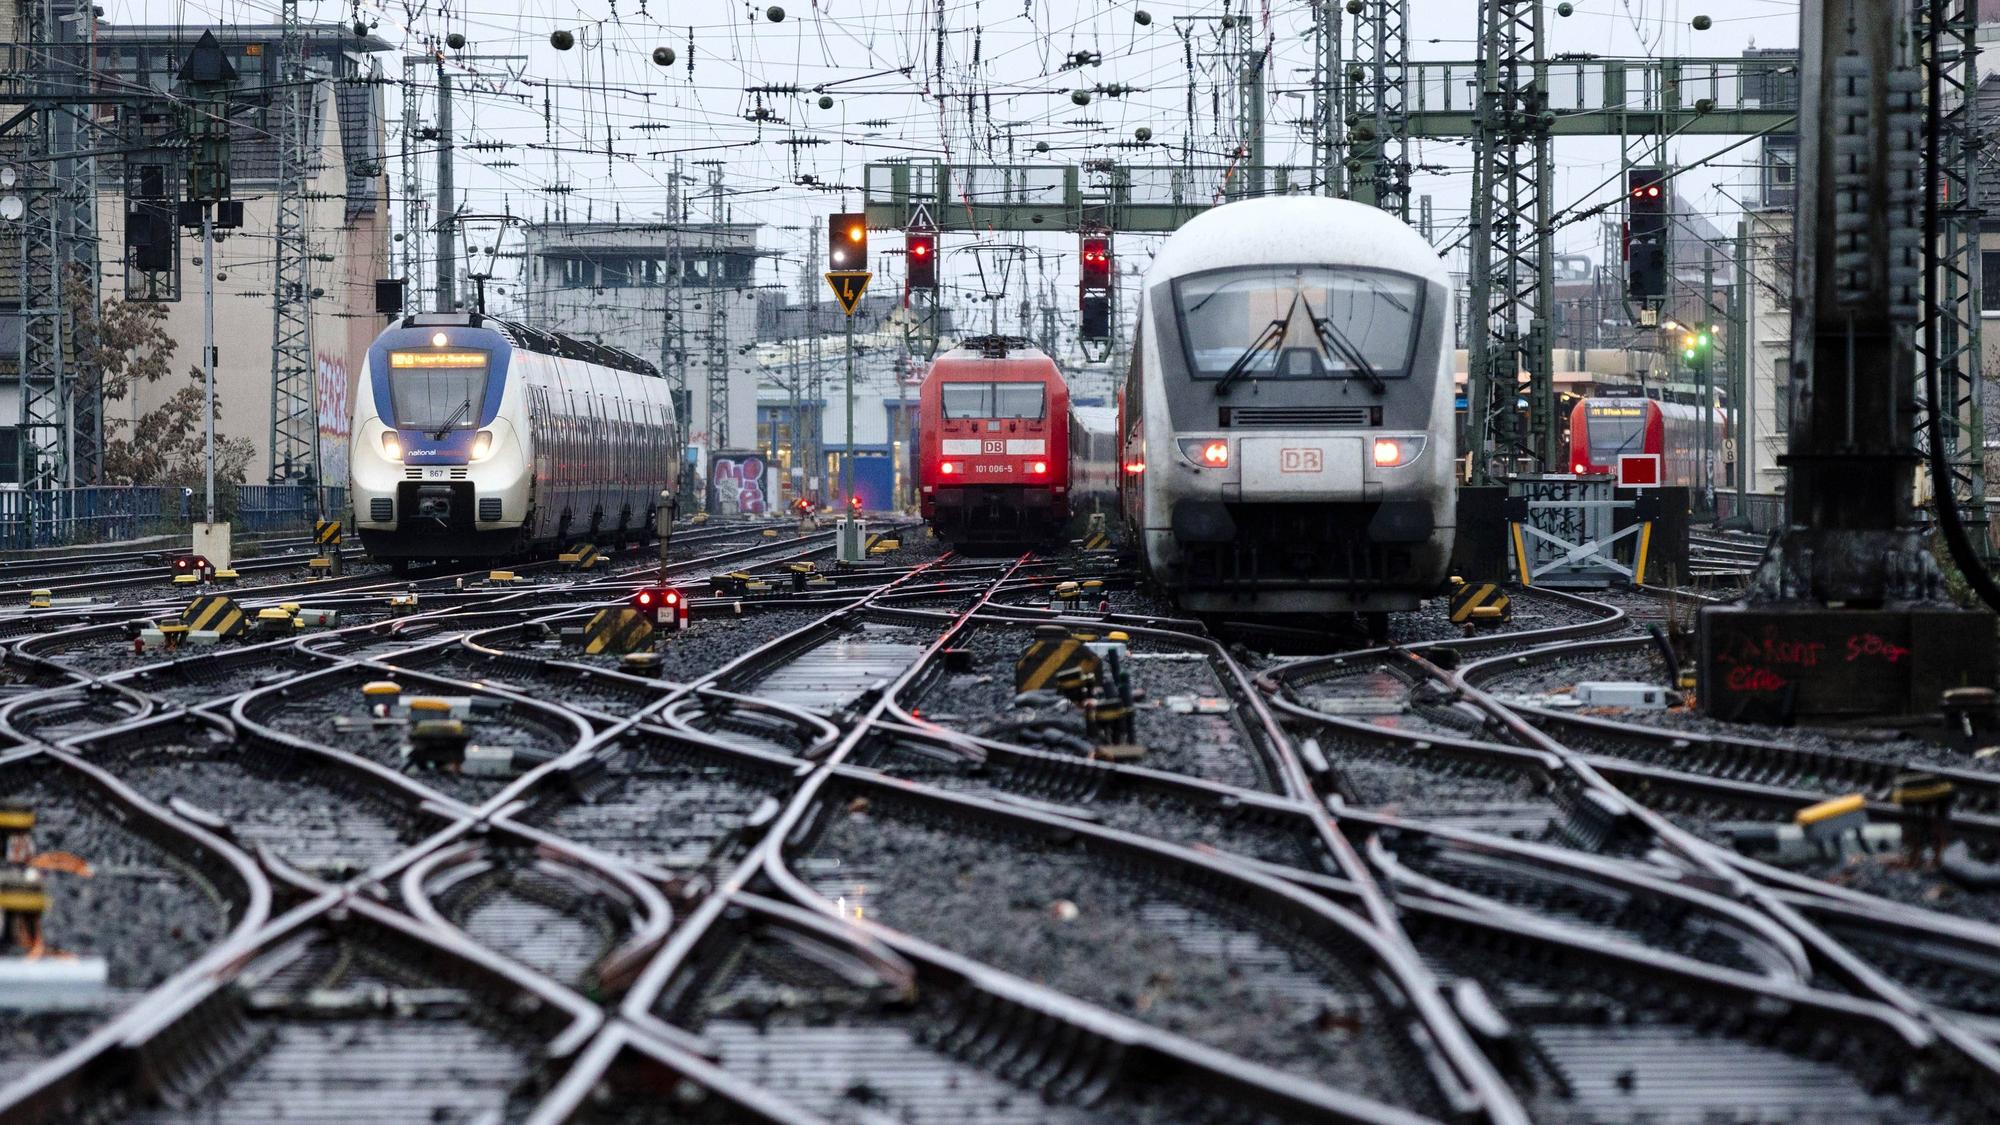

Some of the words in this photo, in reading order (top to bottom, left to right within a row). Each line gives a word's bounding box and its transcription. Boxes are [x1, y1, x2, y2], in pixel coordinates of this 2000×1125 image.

[984, 441, 1004, 453] DB
[1283, 450, 1321, 471] DB
[429, 470, 444, 478] 867
[975, 465, 987, 473] 101
[989, 465, 1013, 473] 006-5
